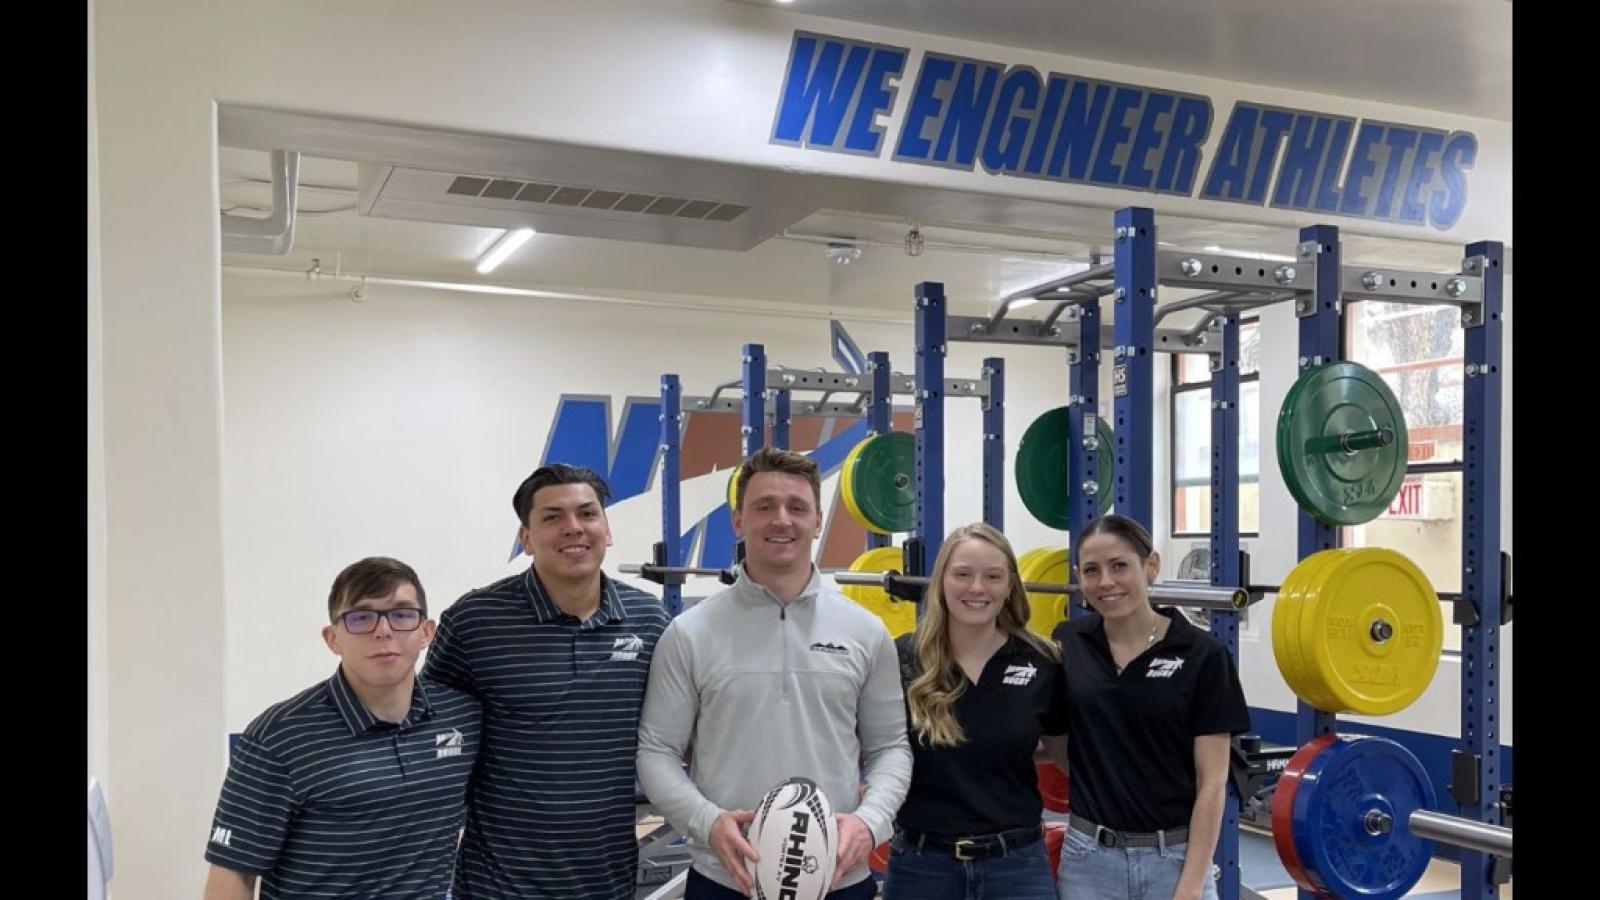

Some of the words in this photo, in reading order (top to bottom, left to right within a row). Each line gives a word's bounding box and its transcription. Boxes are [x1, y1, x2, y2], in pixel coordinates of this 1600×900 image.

[770, 30, 910, 158] WE
[892, 51, 1213, 197] ENGINEER
[1201, 101, 1478, 230] ATHLETES
